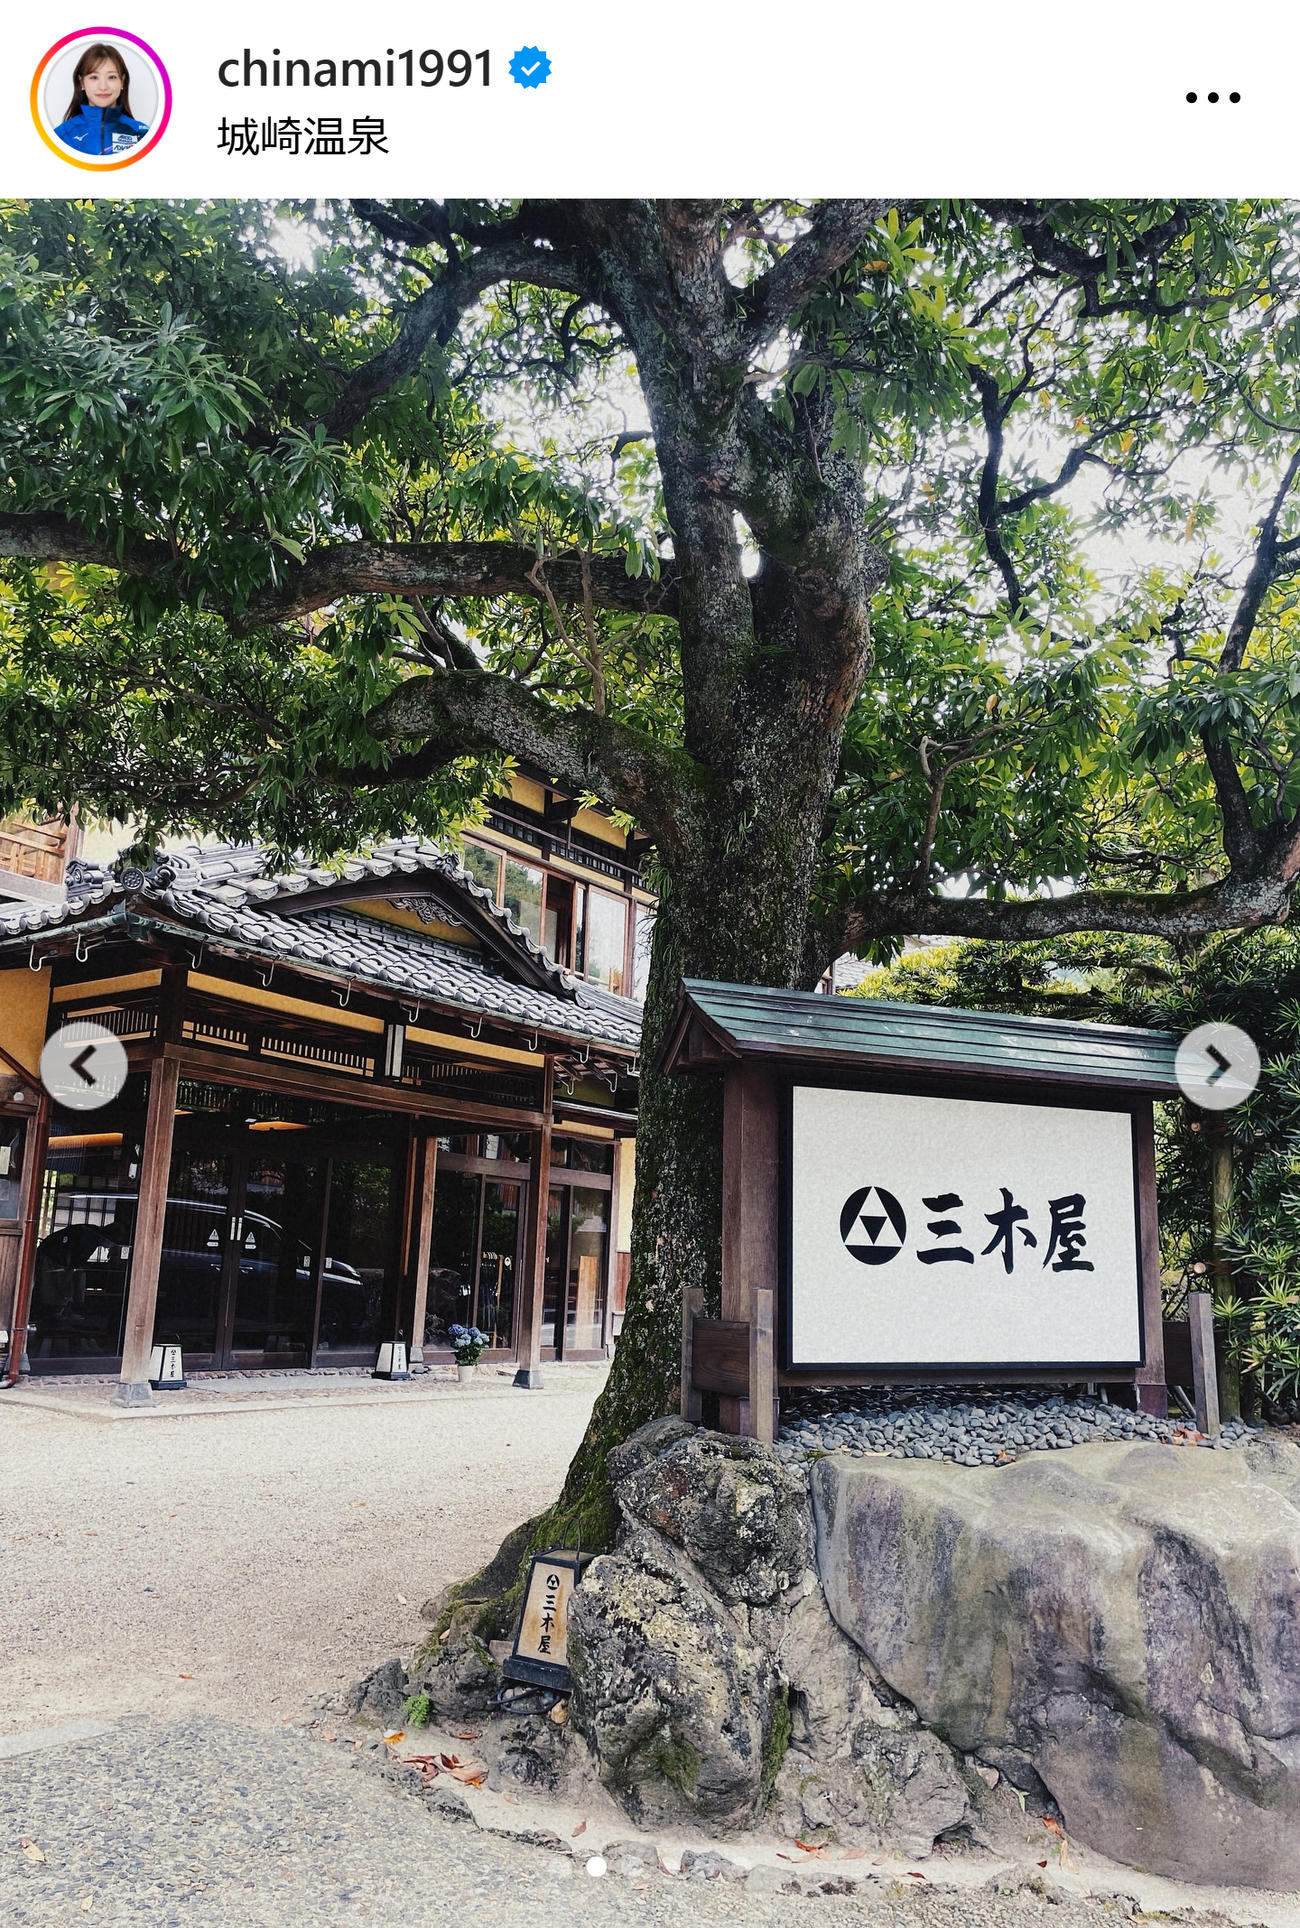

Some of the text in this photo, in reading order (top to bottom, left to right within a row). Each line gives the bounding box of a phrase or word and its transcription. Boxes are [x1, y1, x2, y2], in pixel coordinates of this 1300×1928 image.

[916, 1187, 1095, 1275] 三木屋
[537, 1594, 558, 1655] 三木屋
